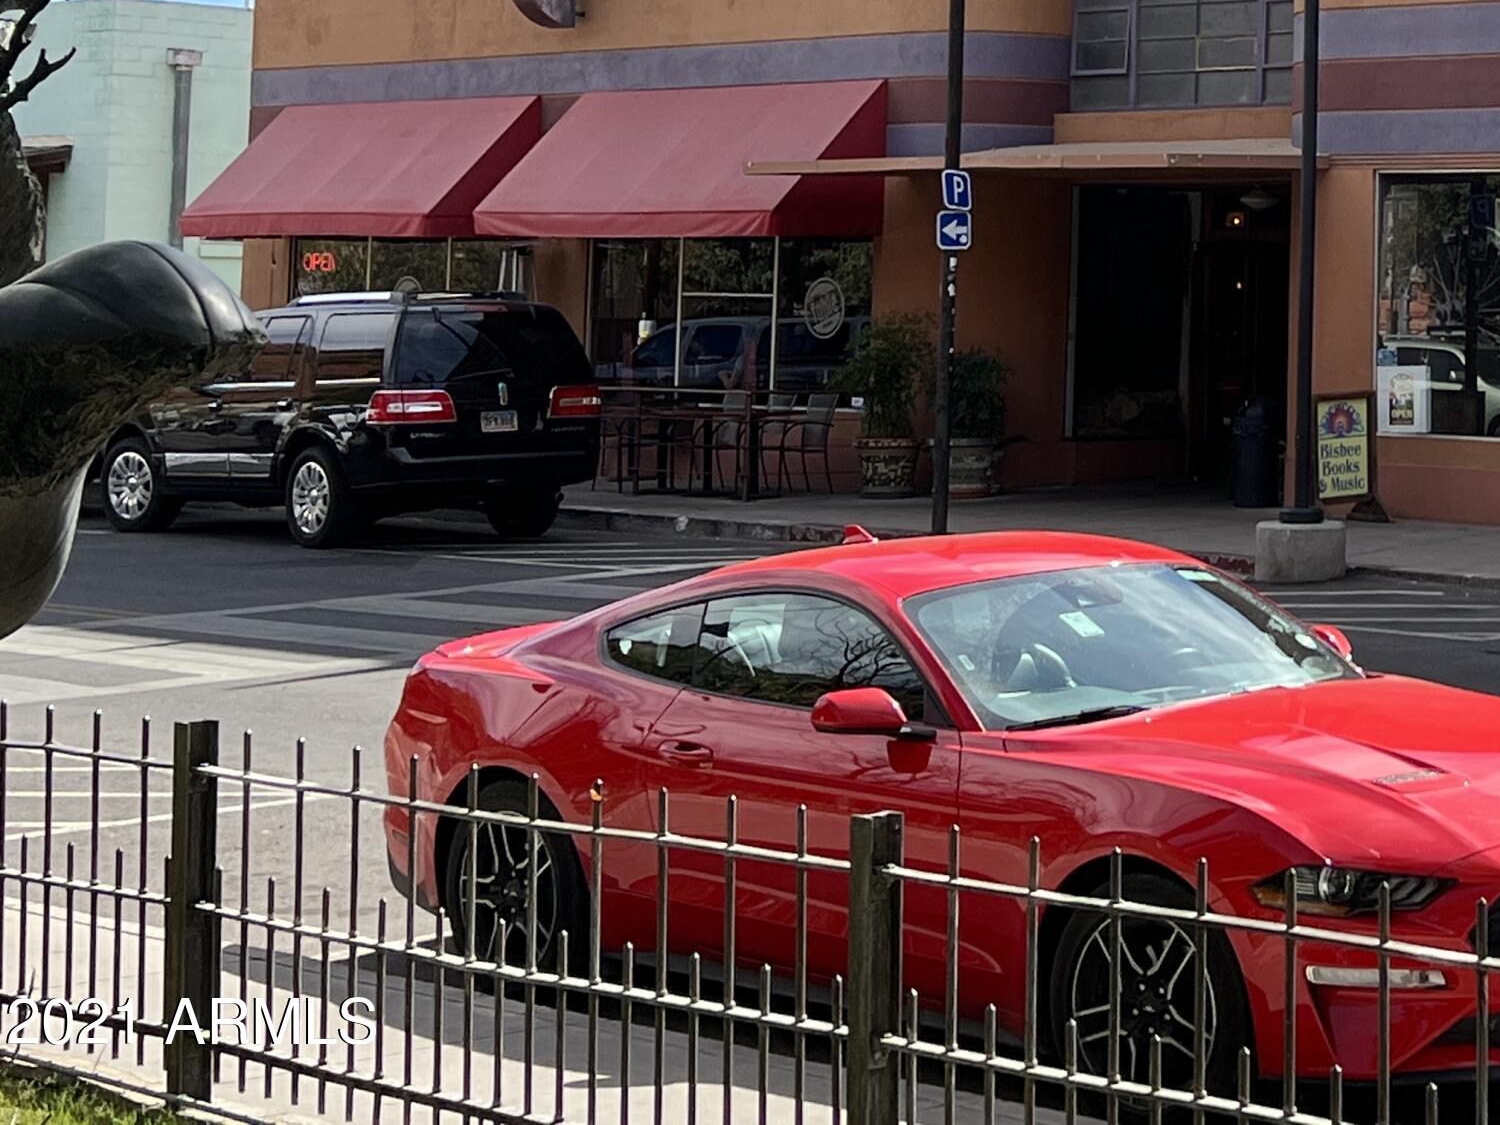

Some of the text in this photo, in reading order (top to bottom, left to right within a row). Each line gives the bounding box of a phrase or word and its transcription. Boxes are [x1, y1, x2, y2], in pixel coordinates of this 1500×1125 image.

[953, 175, 964, 203] P
[1320, 442, 1362, 460] Bisbee
[1322, 459, 1360, 477] Books
[1331, 475, 1365, 492] Music
